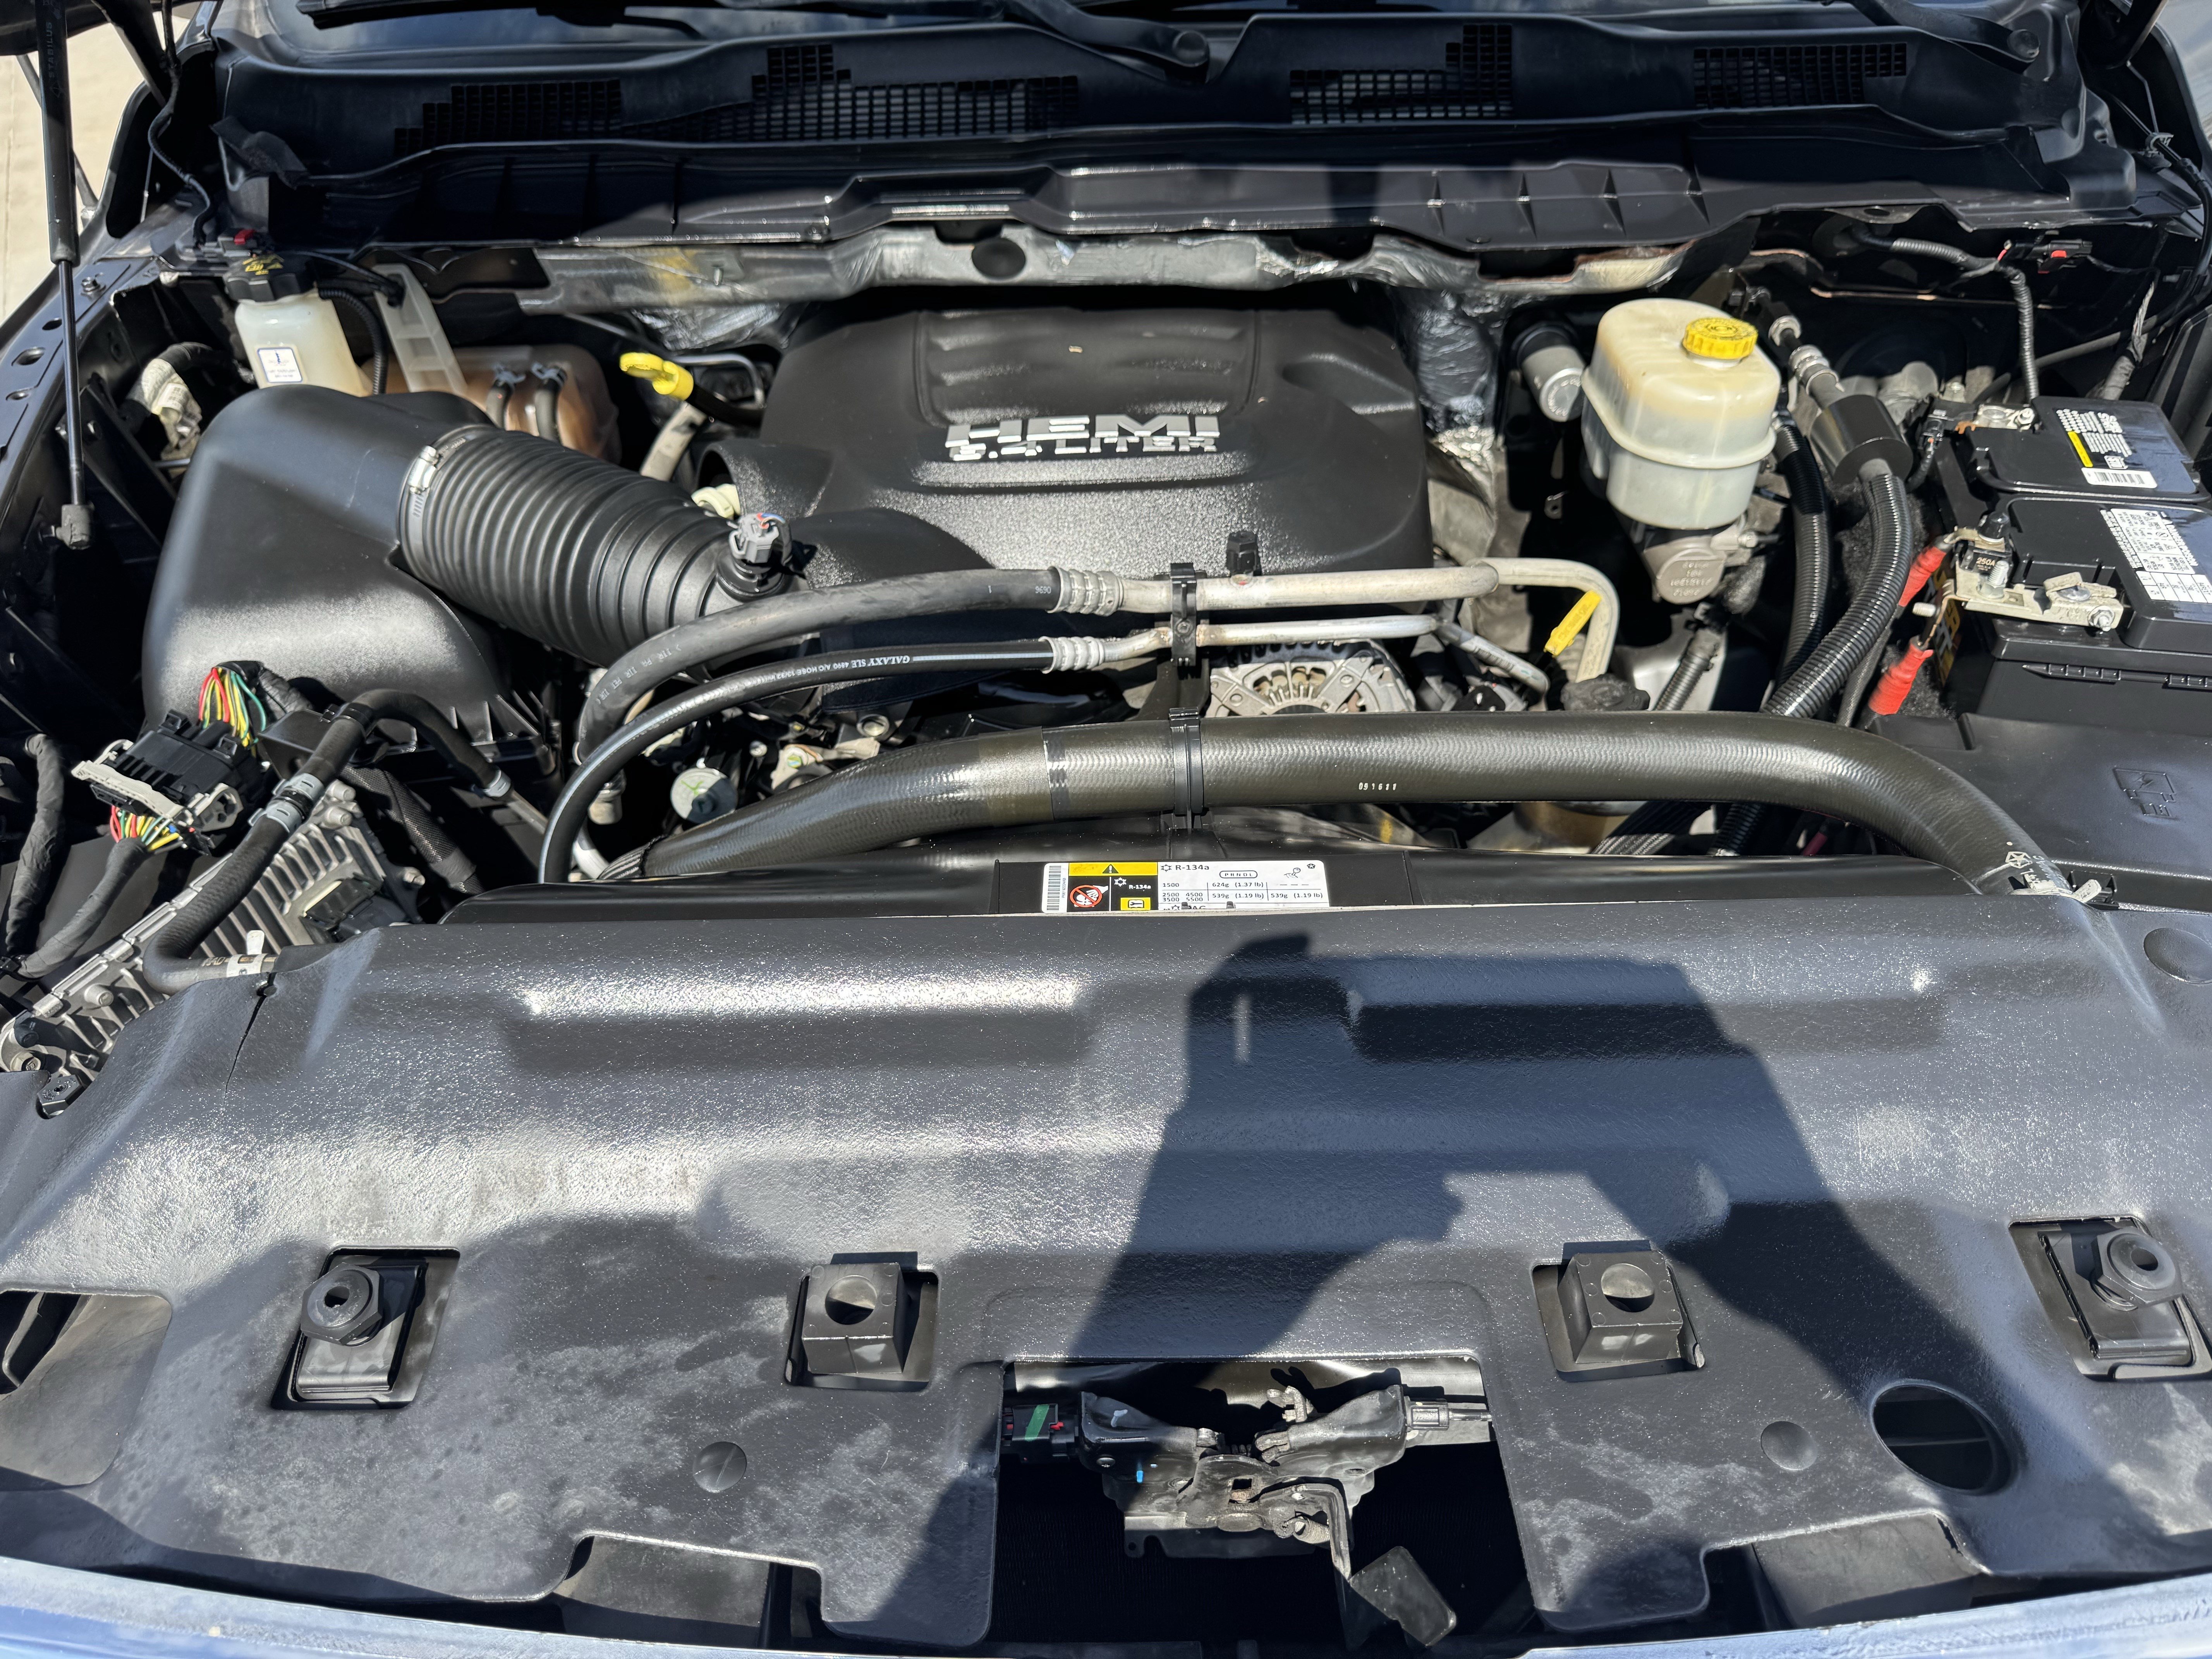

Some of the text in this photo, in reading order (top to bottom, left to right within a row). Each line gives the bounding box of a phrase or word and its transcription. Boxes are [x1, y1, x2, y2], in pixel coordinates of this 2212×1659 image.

[945, 414, 1220, 448] HEMI
[1055, 436, 1217, 455] LITER
[1976, 557, 1996, 567] 250A
[851, 659, 866, 669] SLE
[869, 655, 910, 667] GALAXY
[796, 666, 817, 675] HOSE
